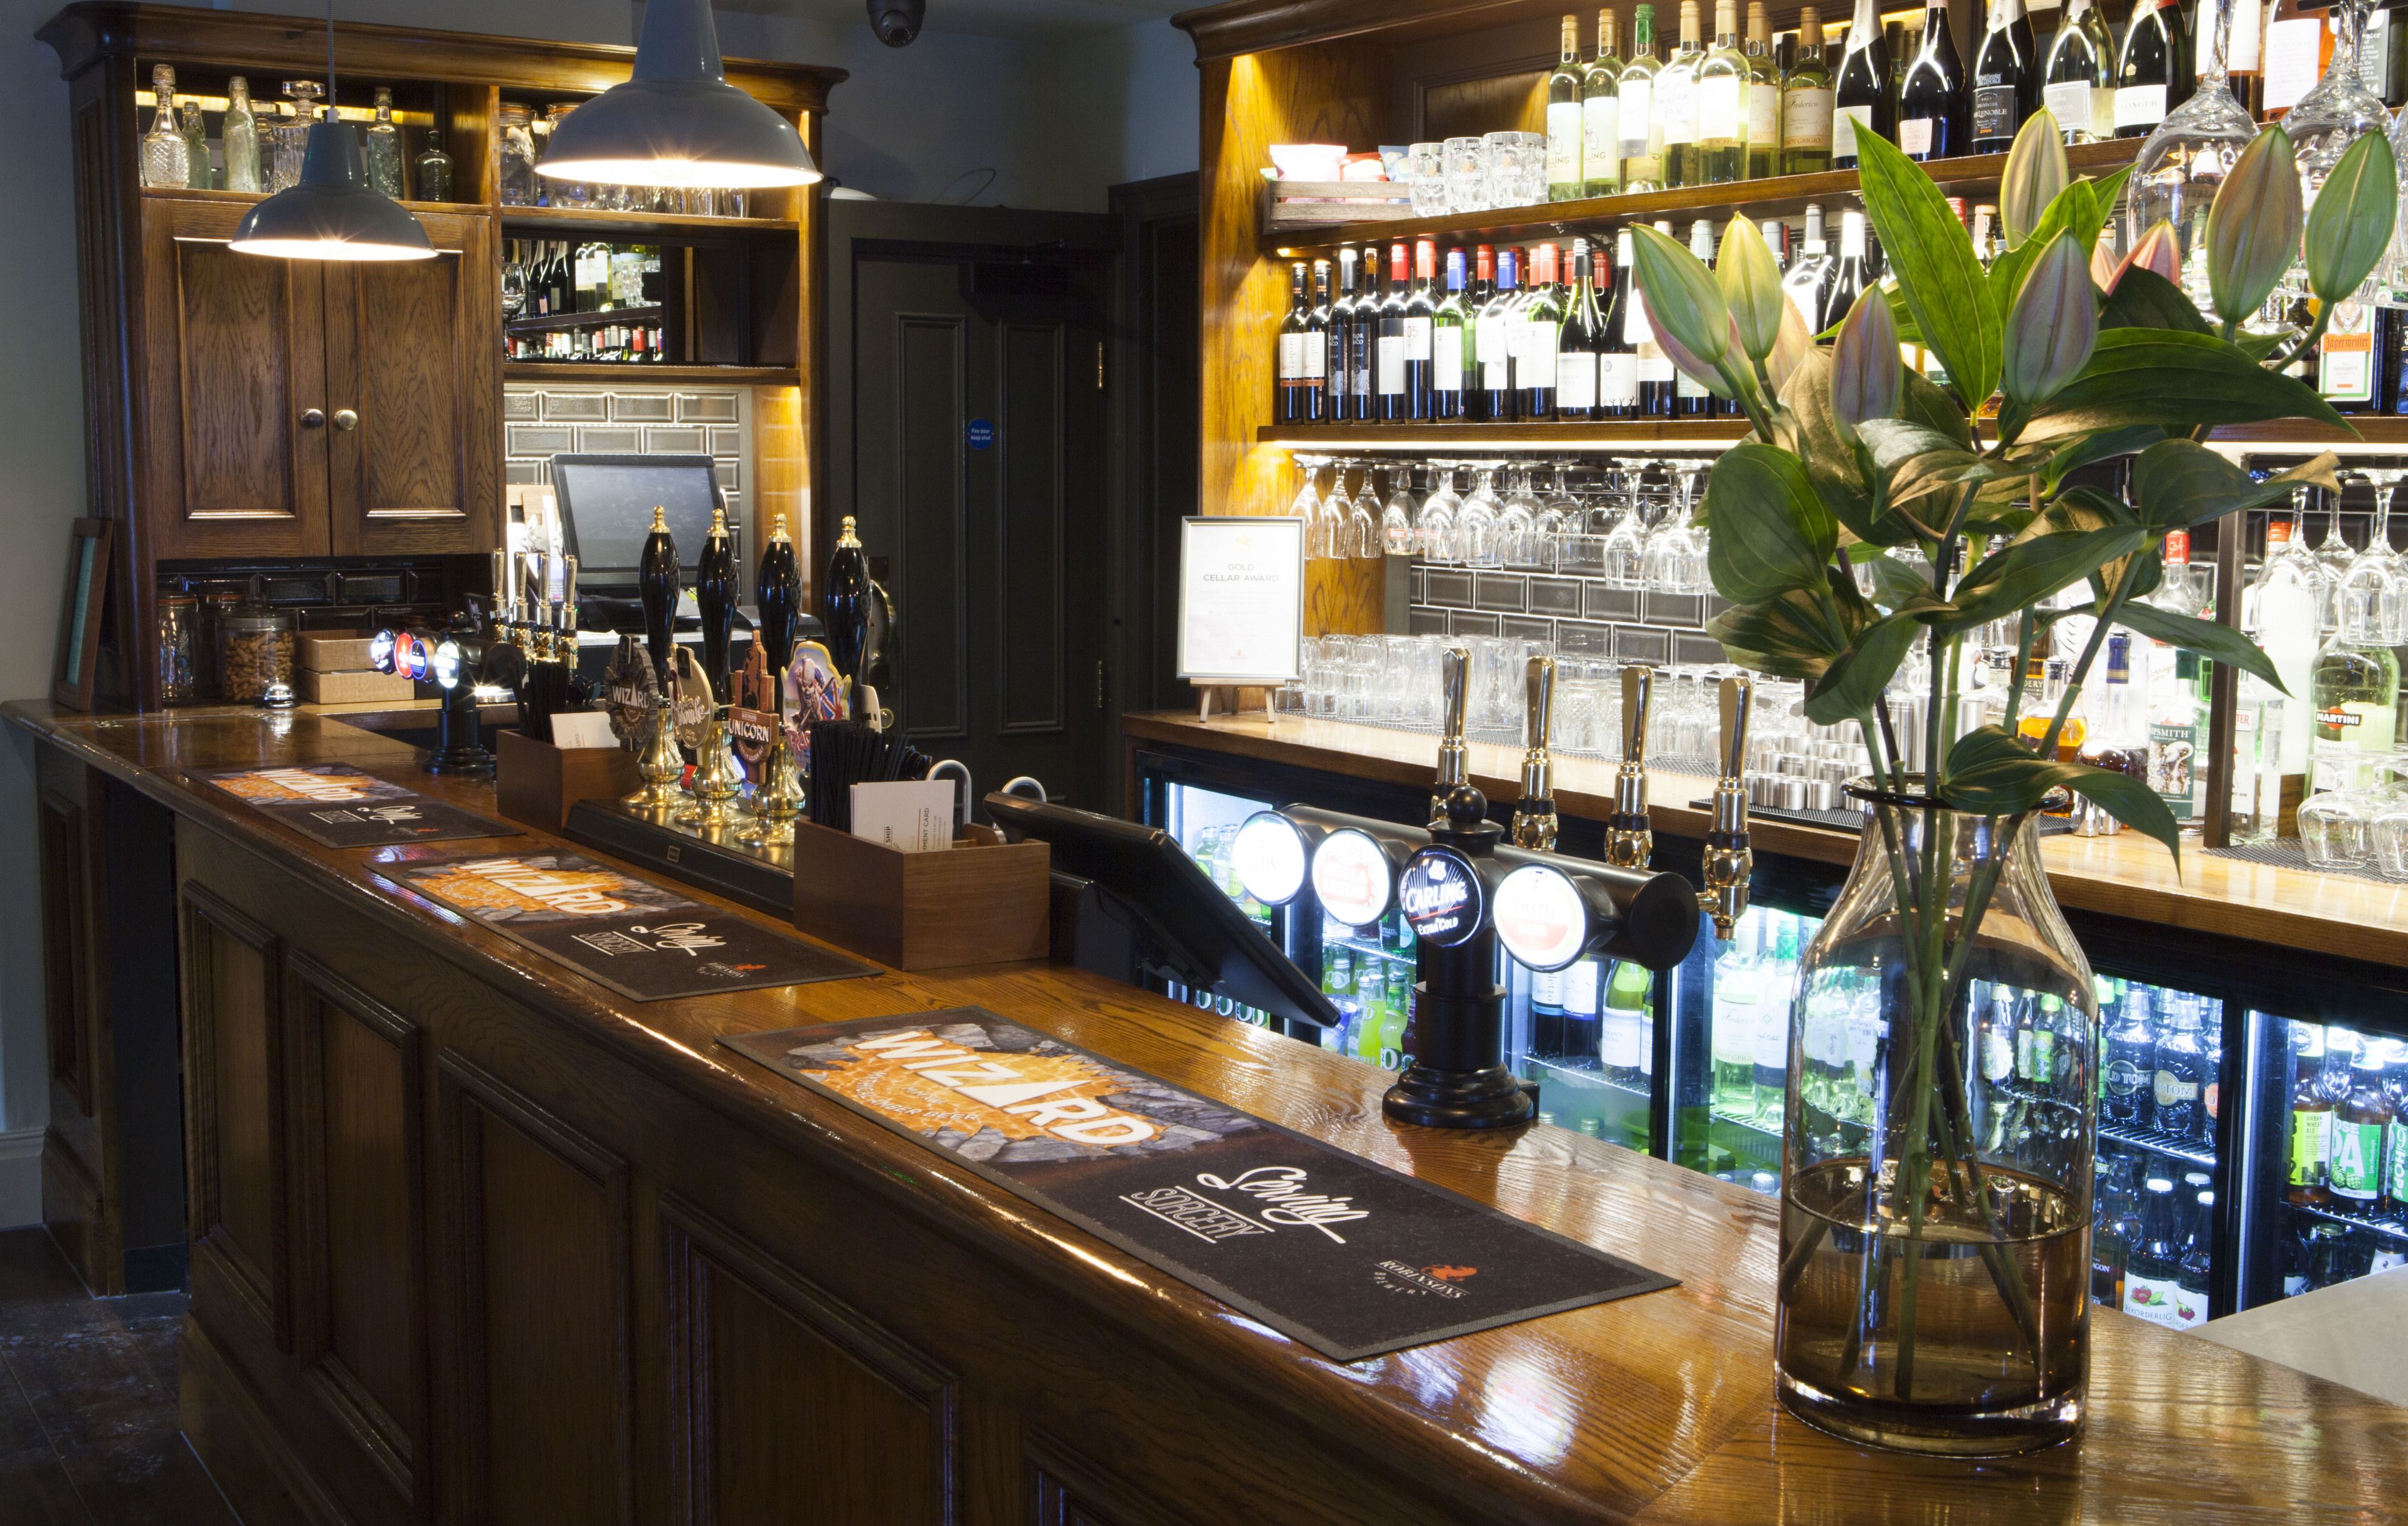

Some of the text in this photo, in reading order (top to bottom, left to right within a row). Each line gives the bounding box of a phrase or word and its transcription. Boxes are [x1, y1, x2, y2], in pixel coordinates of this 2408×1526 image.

[1203, 574, 1240, 582] CELLAR
[1228, 563, 1254, 571] GOLD
[728, 718, 770, 742] UNICORN
[2316, 712, 2360, 725] MARTINI
[460, 859, 628, 915] WIZARD
[1405, 880, 1467, 913] CARLING
[854, 1030, 1155, 1145] WIZARD
[2121, 1072, 2152, 1085] TOM
[2165, 1084, 2194, 1097] TOM
[869, 1098, 921, 1115] AMBER
[926, 1112, 980, 1121] BEER
[1130, 1187, 1265, 1239] SORCERY
[1196, 1166, 1370, 1244] Serving
[1378, 1259, 1464, 1300] ROBINSONS
[2125, 1303, 2173, 1320] REKORDERLIG
